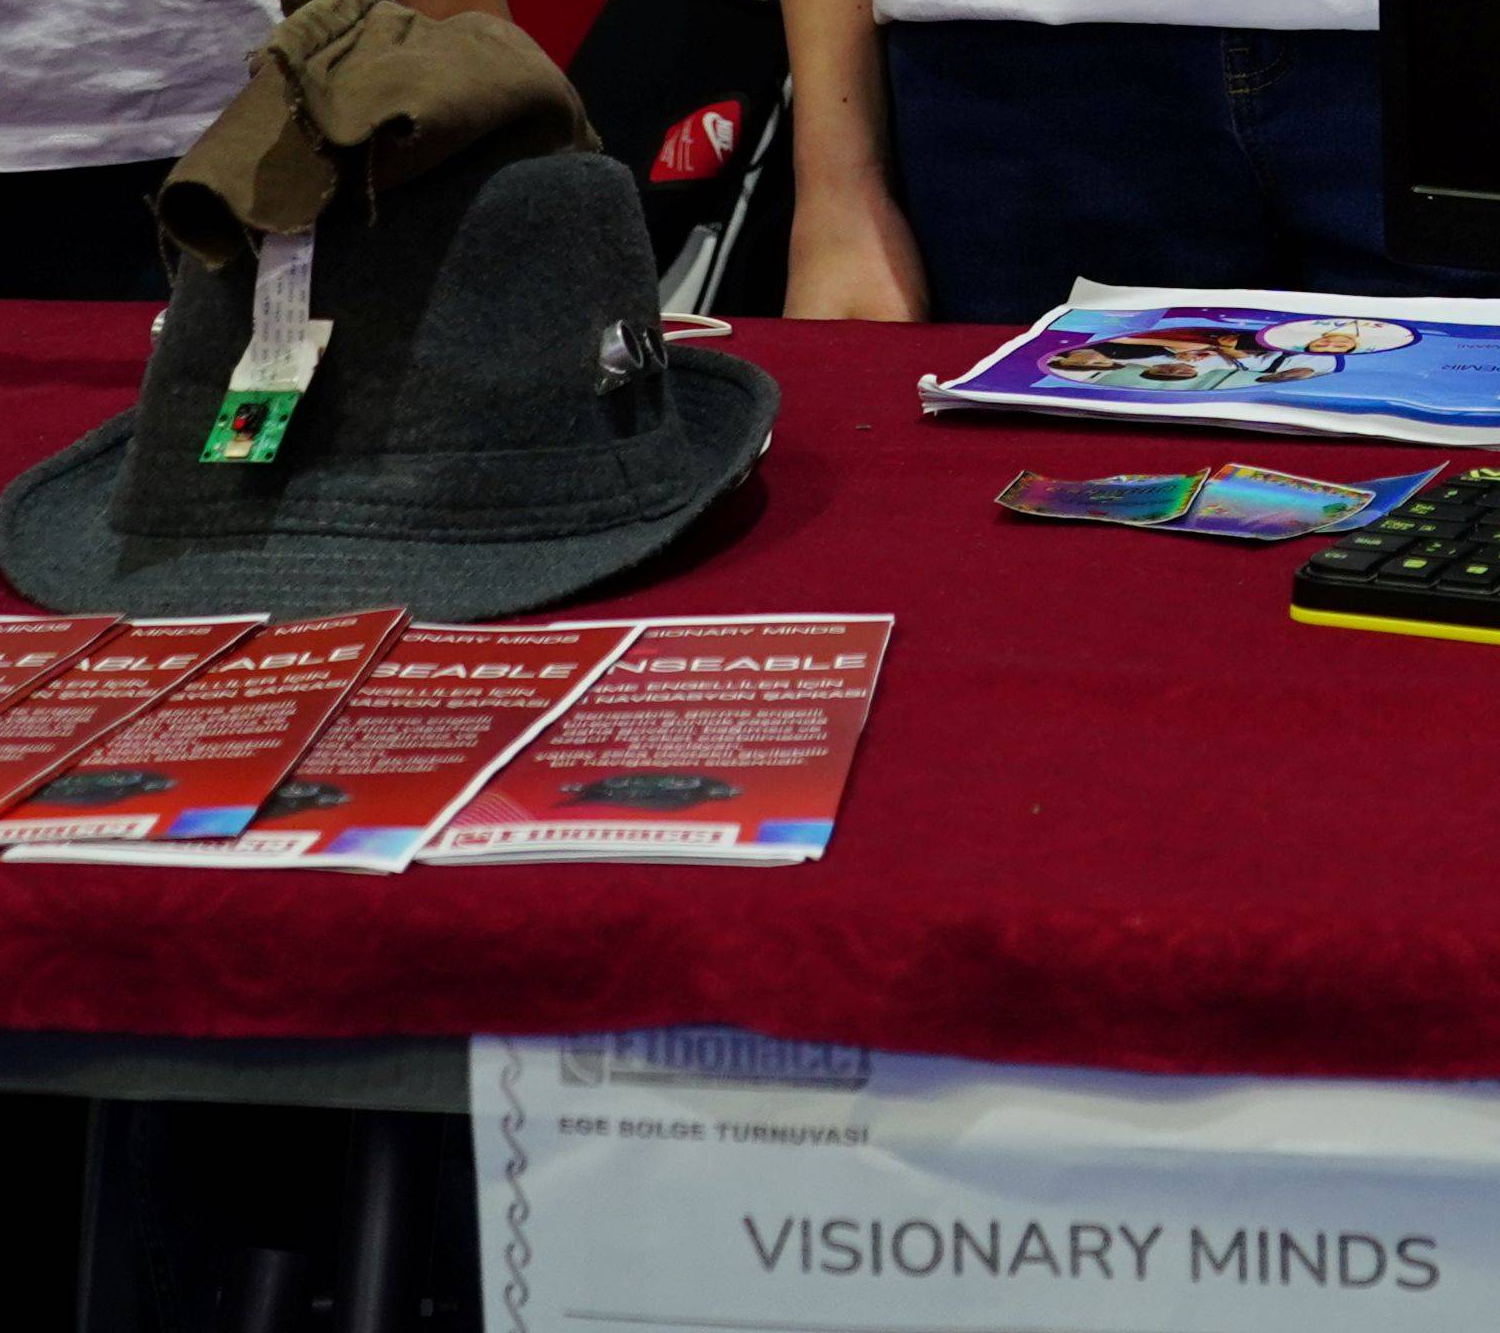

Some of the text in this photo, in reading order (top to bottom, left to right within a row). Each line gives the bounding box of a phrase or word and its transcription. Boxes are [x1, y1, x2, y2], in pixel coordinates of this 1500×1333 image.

[401, 632, 492, 645] ONARY
[643, 625, 847, 640] SIONARY MINDS
[370, 661, 579, 680] SEABLE
[606, 652, 869, 676] NSEABLE
[743, 1213, 1442, 1293] VISIONARY MINDS
